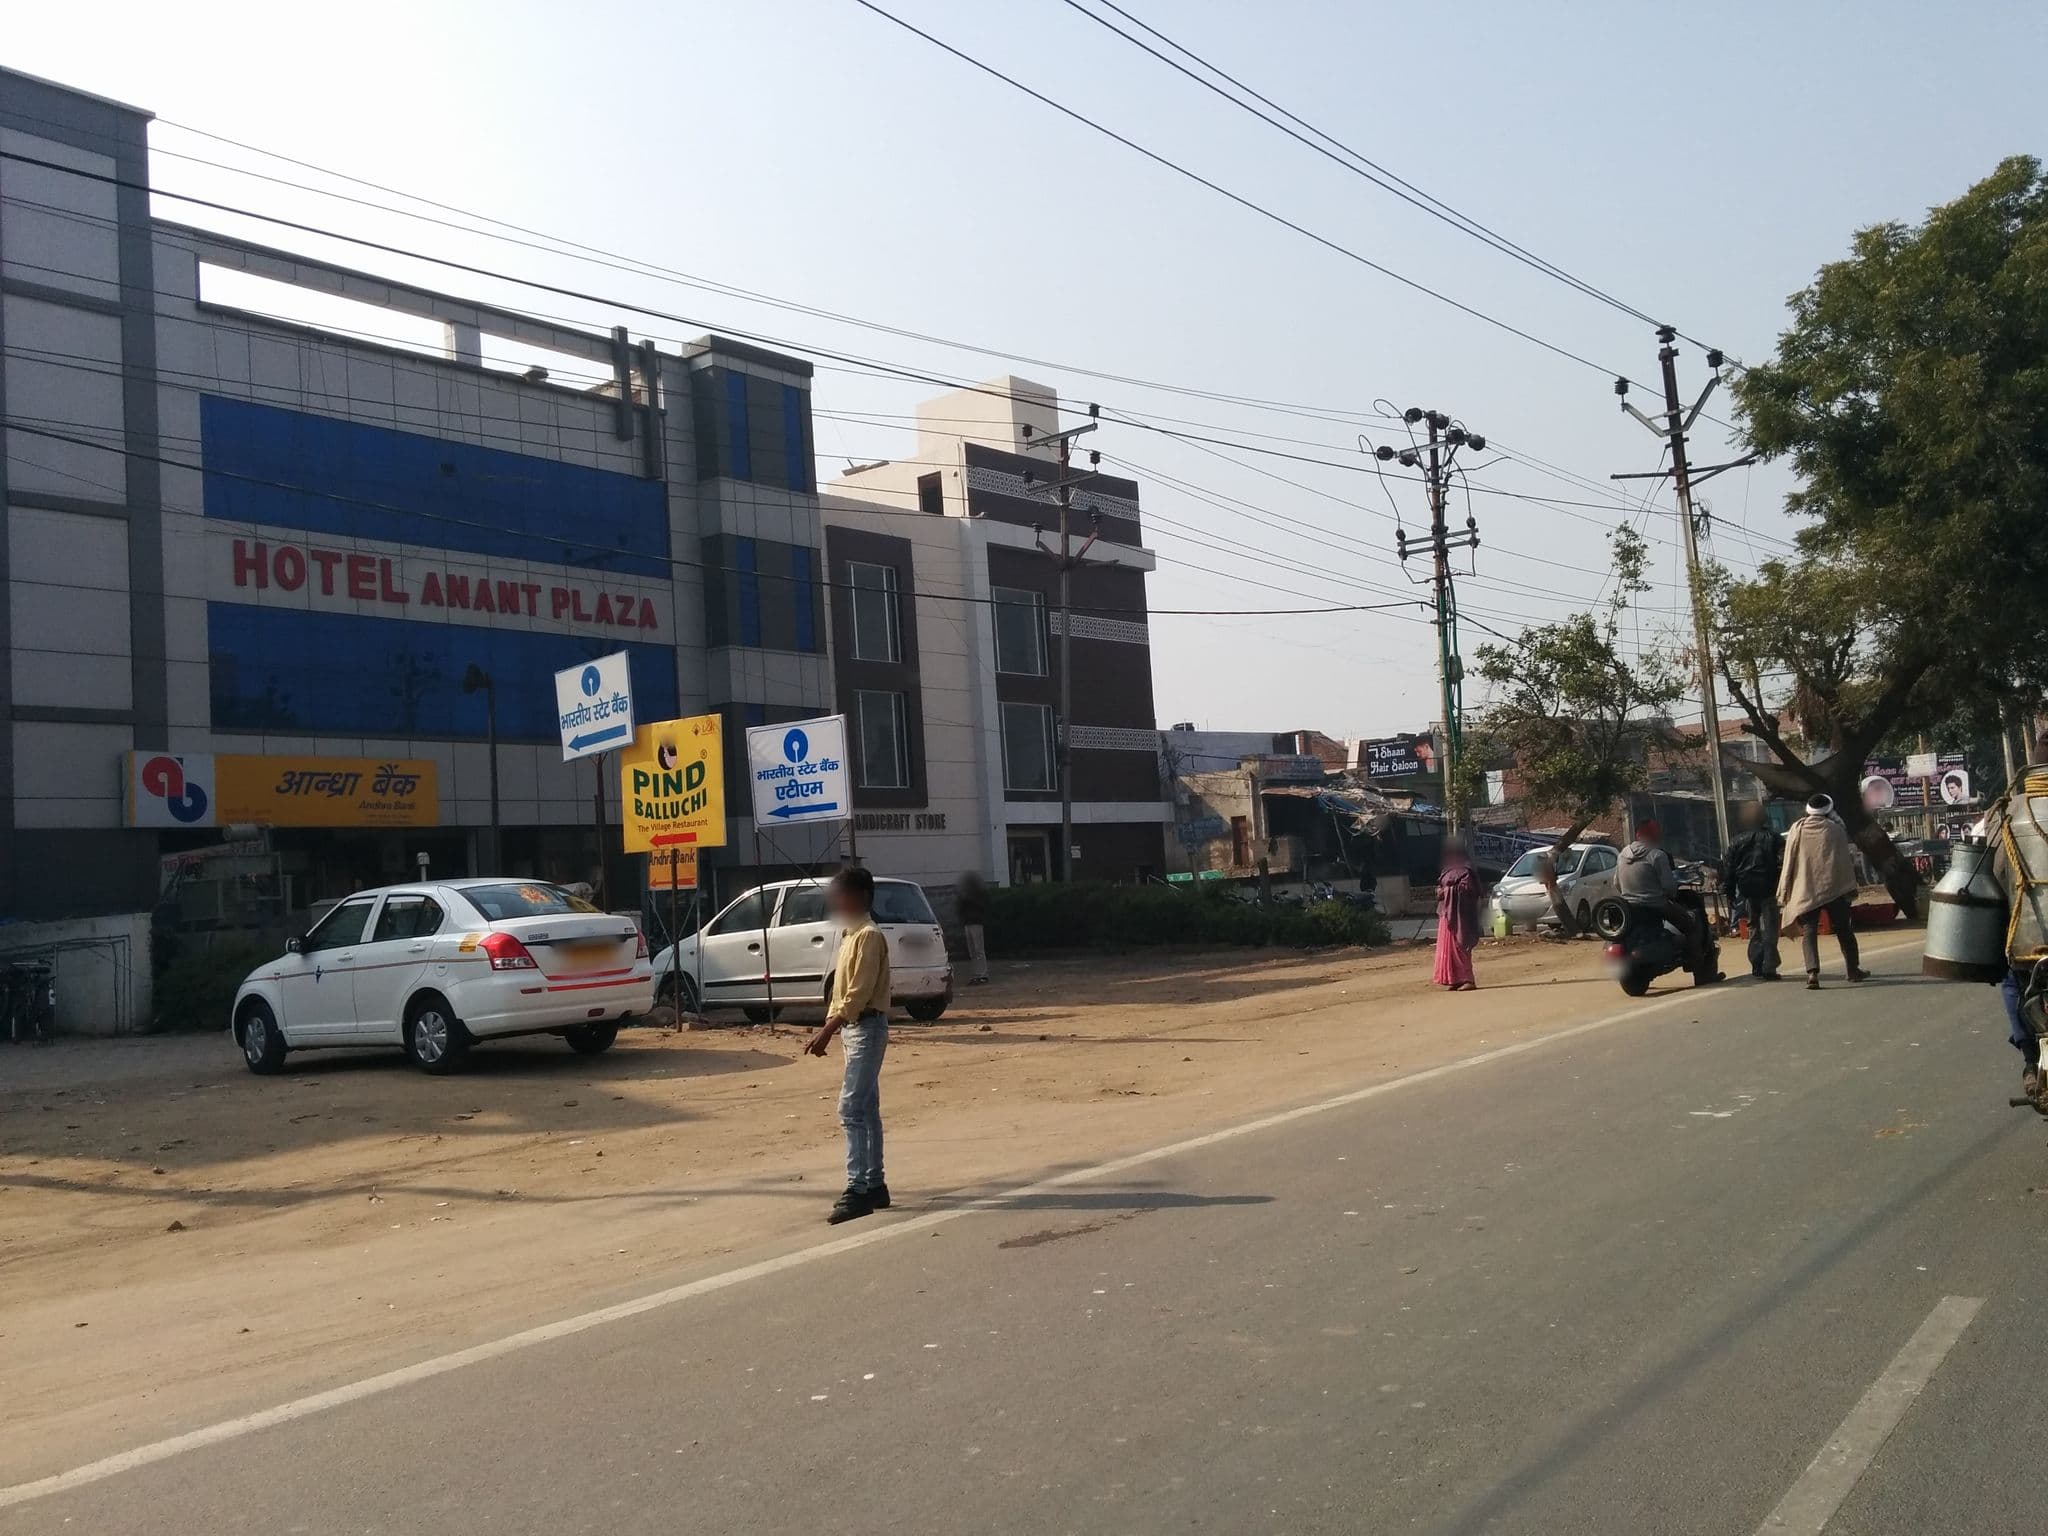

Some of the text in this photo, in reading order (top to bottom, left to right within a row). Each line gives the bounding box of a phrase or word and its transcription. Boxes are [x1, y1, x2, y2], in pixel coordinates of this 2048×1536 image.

[233, 540, 659, 630] HOTEL ANANT PLAZA
[560, 691, 629, 730] भारतीय स्टेट बैंक
[1380, 746, 1405, 758] Shaan
[757, 758, 840, 781] भारतीय स्टेट बैंक
[1370, 759, 1418, 774] Hair Saloon
[275, 764, 422, 798] आन्ध्रा बैंक
[633, 760, 706, 799] PIND
[774, 779, 825, 801] एटीएम
[634, 787, 707, 821] BALLUCHI
[638, 819, 709, 833] The Village Restaurant
[855, 813, 947, 831] ANDICRAFT STORE
